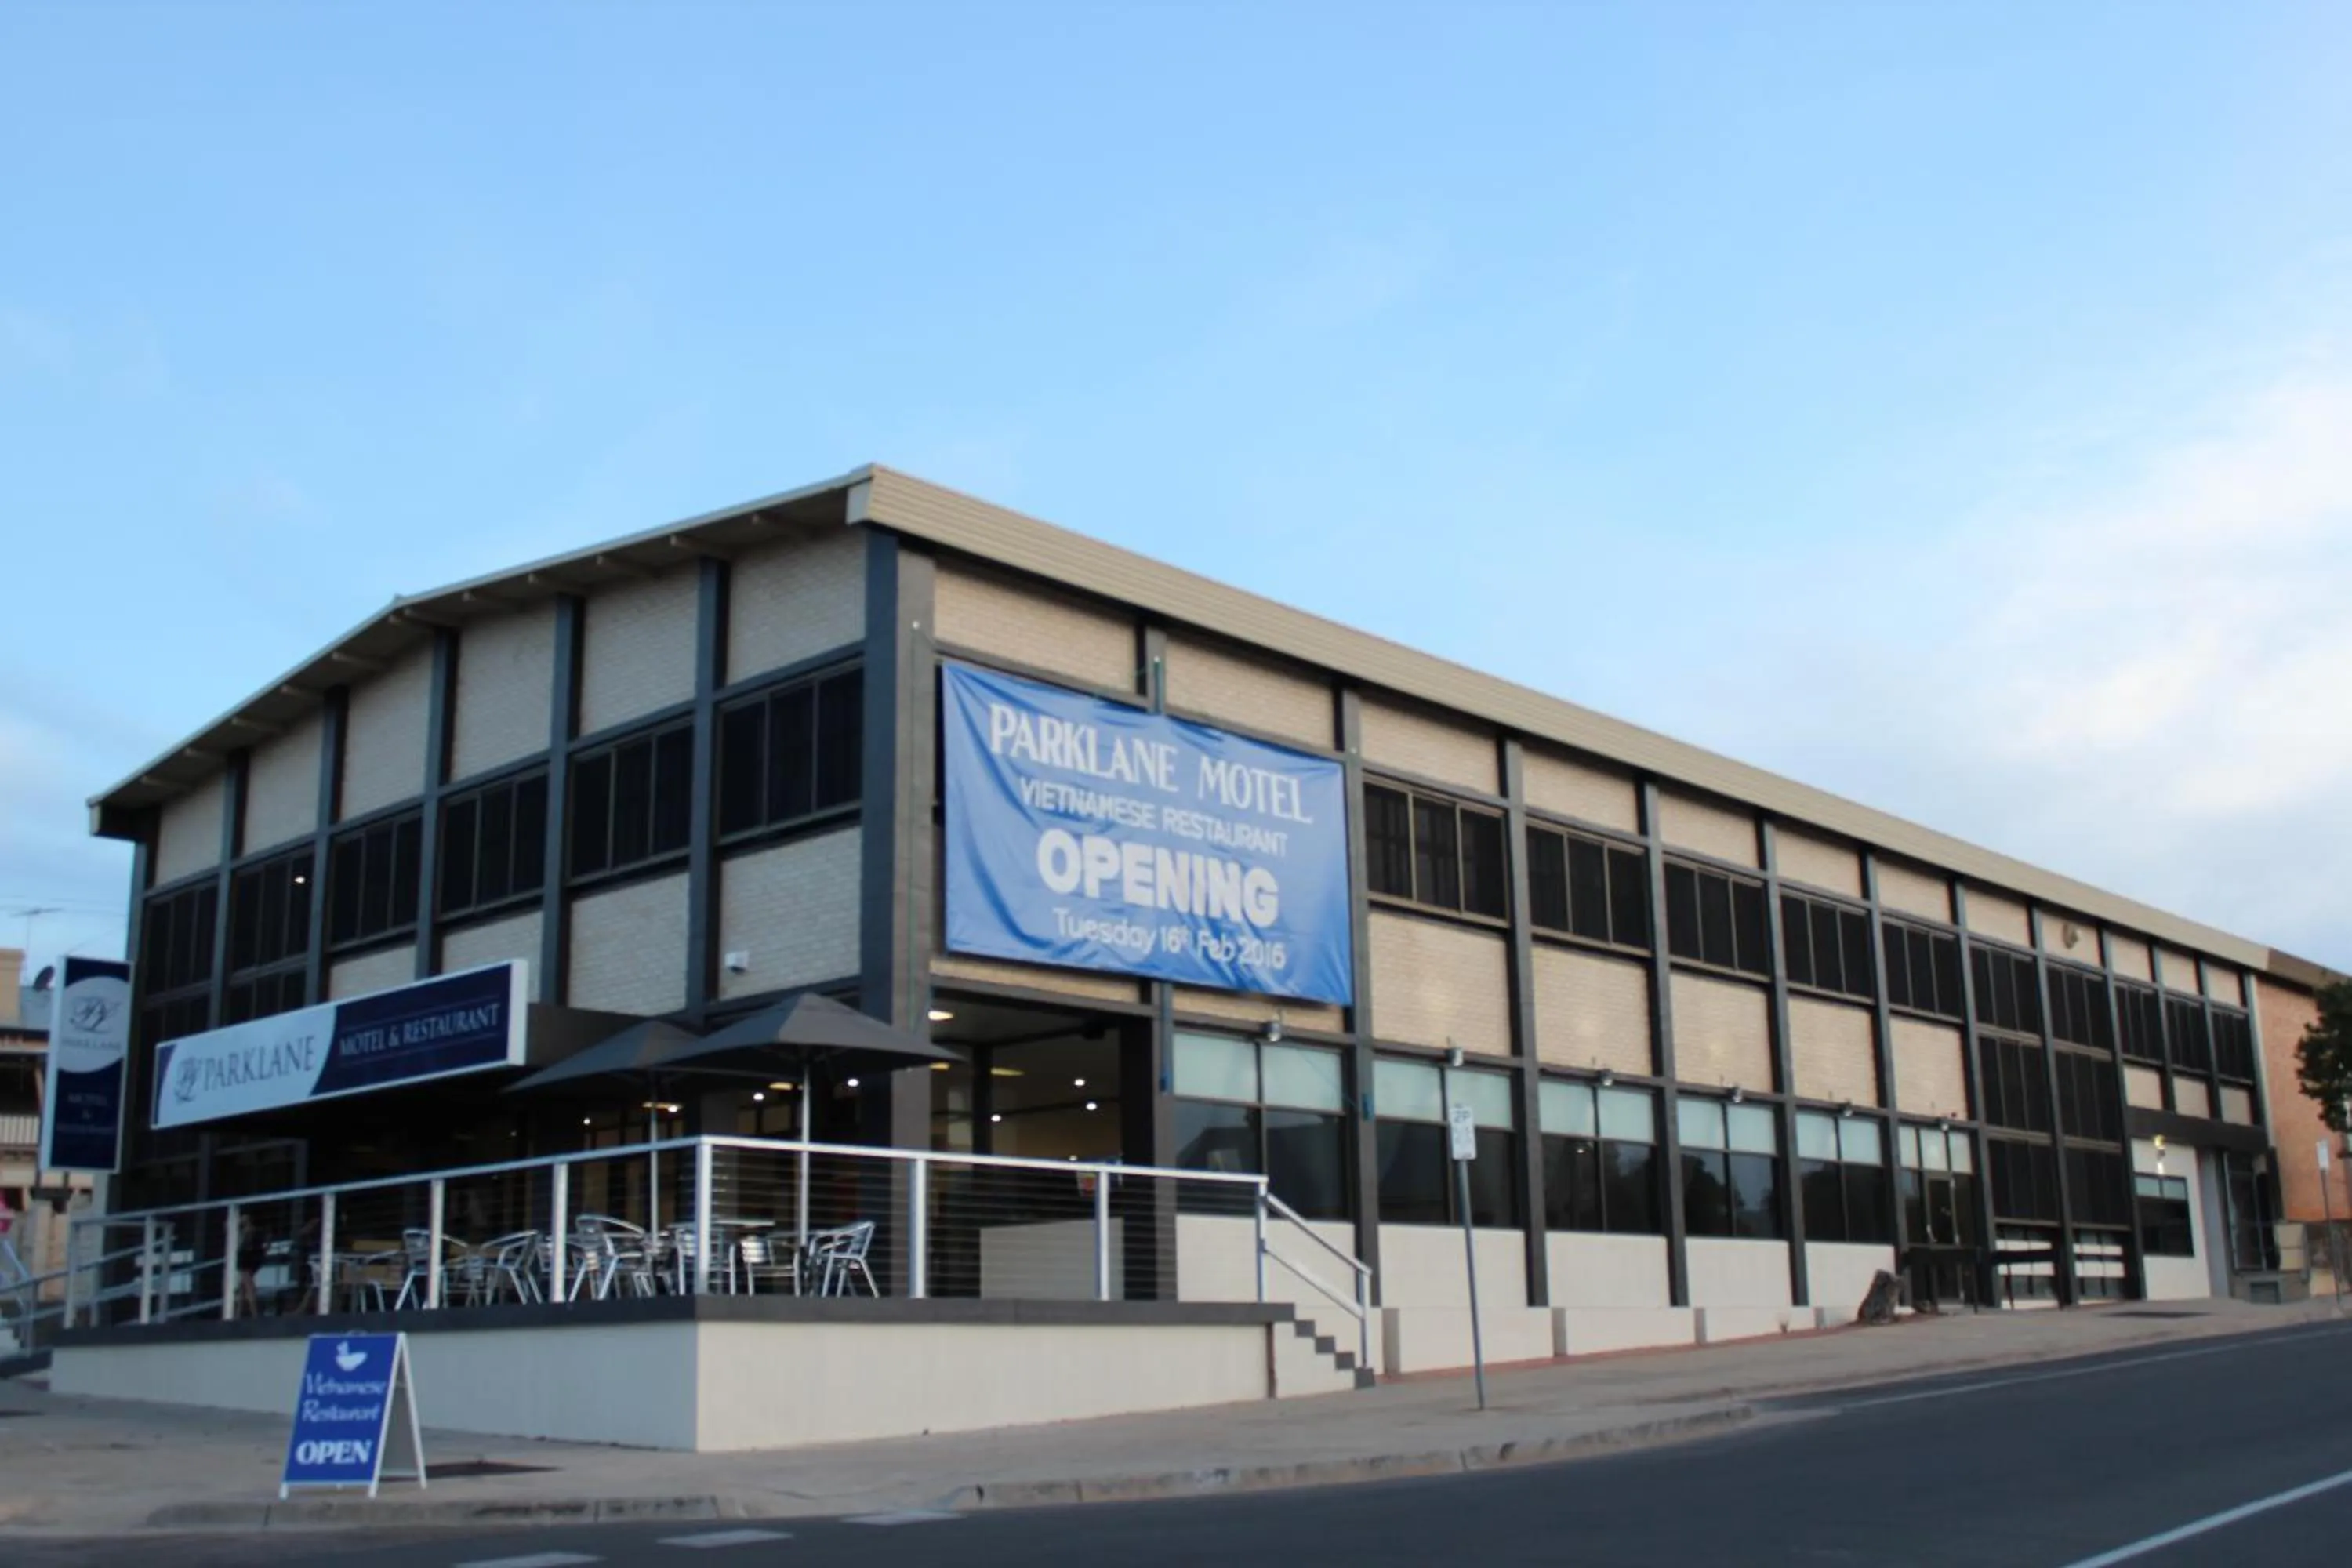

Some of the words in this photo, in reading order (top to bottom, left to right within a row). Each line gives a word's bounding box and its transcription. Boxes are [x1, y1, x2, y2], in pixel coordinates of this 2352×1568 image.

[989, 702, 1179, 793] PARKLANE
[1198, 754, 1313, 825] MOTEL
[1020, 778, 1156, 828] VIETNAMESE
[1163, 808, 1287, 857] RESTAURANT
[1037, 829, 1279, 927] OPENING
[1053, 906, 1157, 955] Tuesday
[1236, 937, 1287, 971] 2016
[339, 1029, 387, 1056] MOTEL
[388, 1025, 401, 1047] &
[403, 1003, 501, 1044] RESTAURANT
[203, 1035, 315, 1091] PARKLANE
[295, 1439, 372, 1465] OPEN
